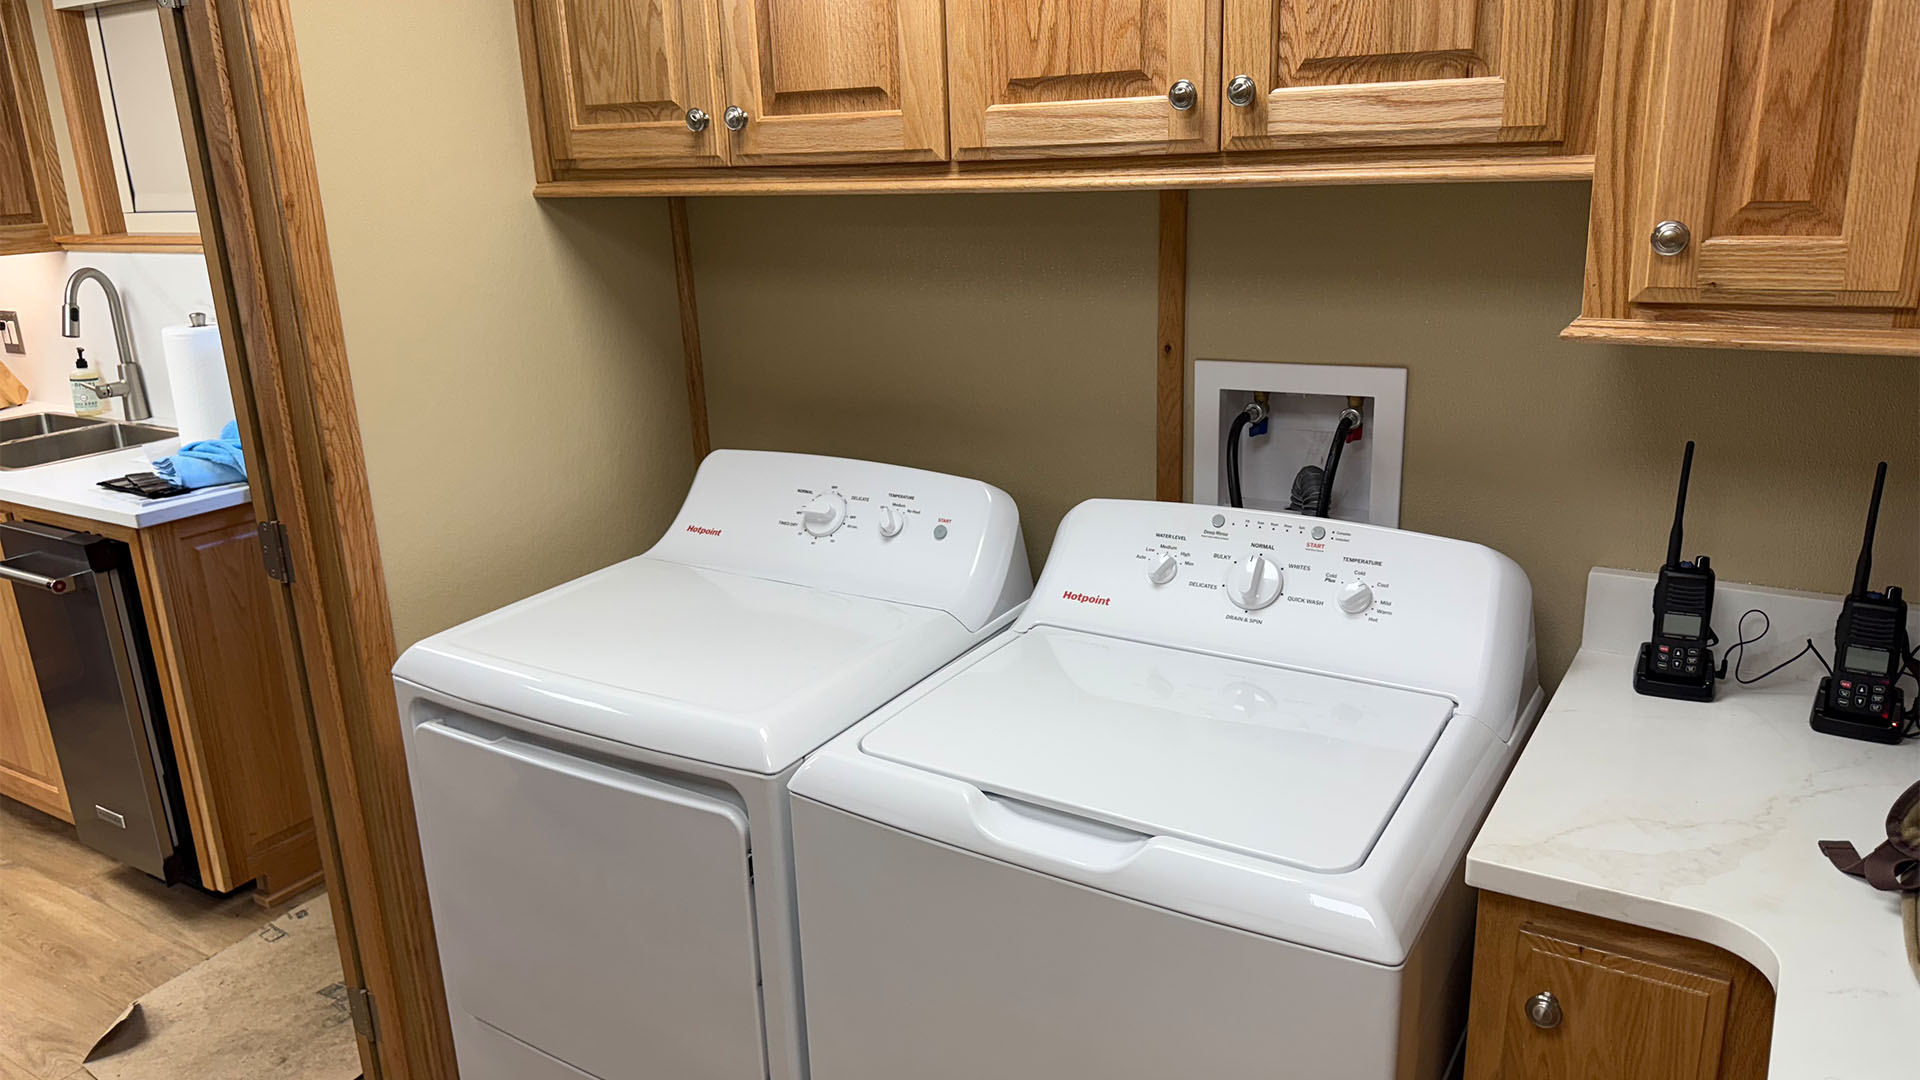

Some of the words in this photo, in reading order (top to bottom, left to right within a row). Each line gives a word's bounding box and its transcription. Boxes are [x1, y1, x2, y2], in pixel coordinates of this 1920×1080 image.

[686, 525, 722, 536] Hotpoint
[1251, 542, 1275, 551] NORMAL
[1343, 556, 1383, 567] TEMPERATURE
[1288, 563, 1311, 571] WHITES
[1353, 569, 1367, 577] Cold
[1188, 581, 1218, 590] DELICATES
[1063, 591, 1111, 606] Hotpoint
[1287, 595, 1306, 604] QUICK
[1225, 614, 1244, 622] DRAIN
